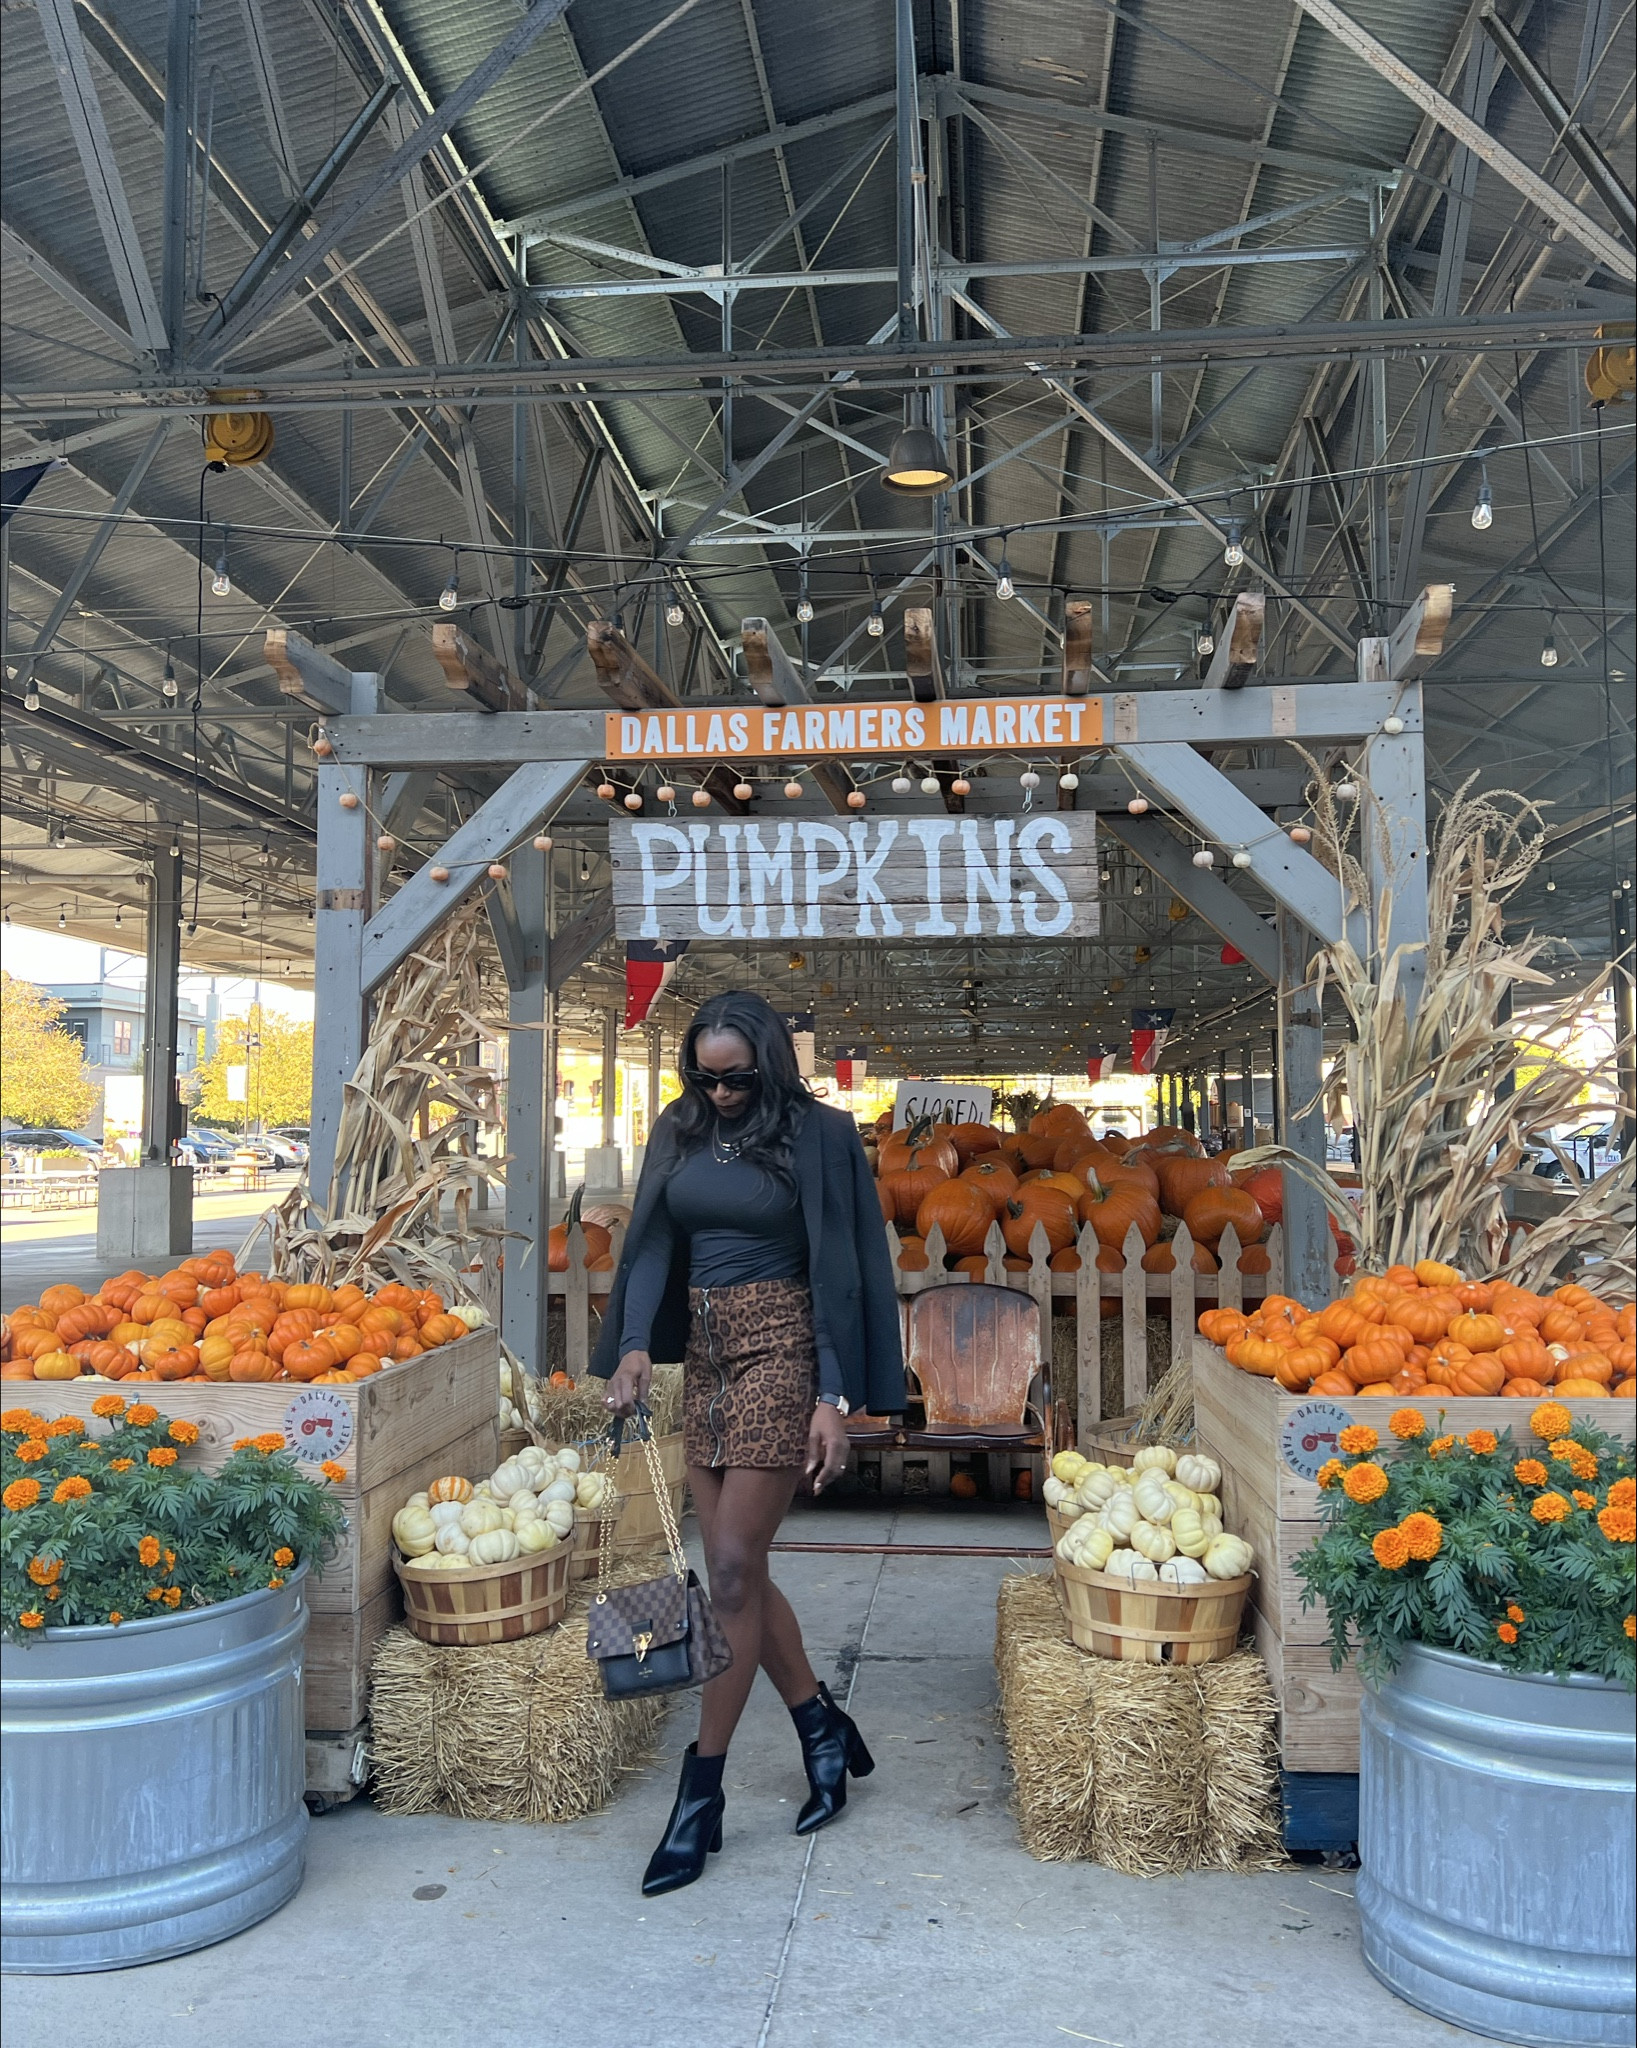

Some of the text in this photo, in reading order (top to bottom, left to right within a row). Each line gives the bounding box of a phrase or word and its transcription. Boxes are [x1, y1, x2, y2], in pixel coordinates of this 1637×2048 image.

[620, 703, 1086, 754] DALLAS FARMERS MARKET
[631, 817, 1074, 938] PUMPKINS
[300, 1391, 342, 1408] DALLAS
[1297, 1404, 1345, 1420] DALLAS
[285, 1419, 351, 1461] FARMERS MARKET
